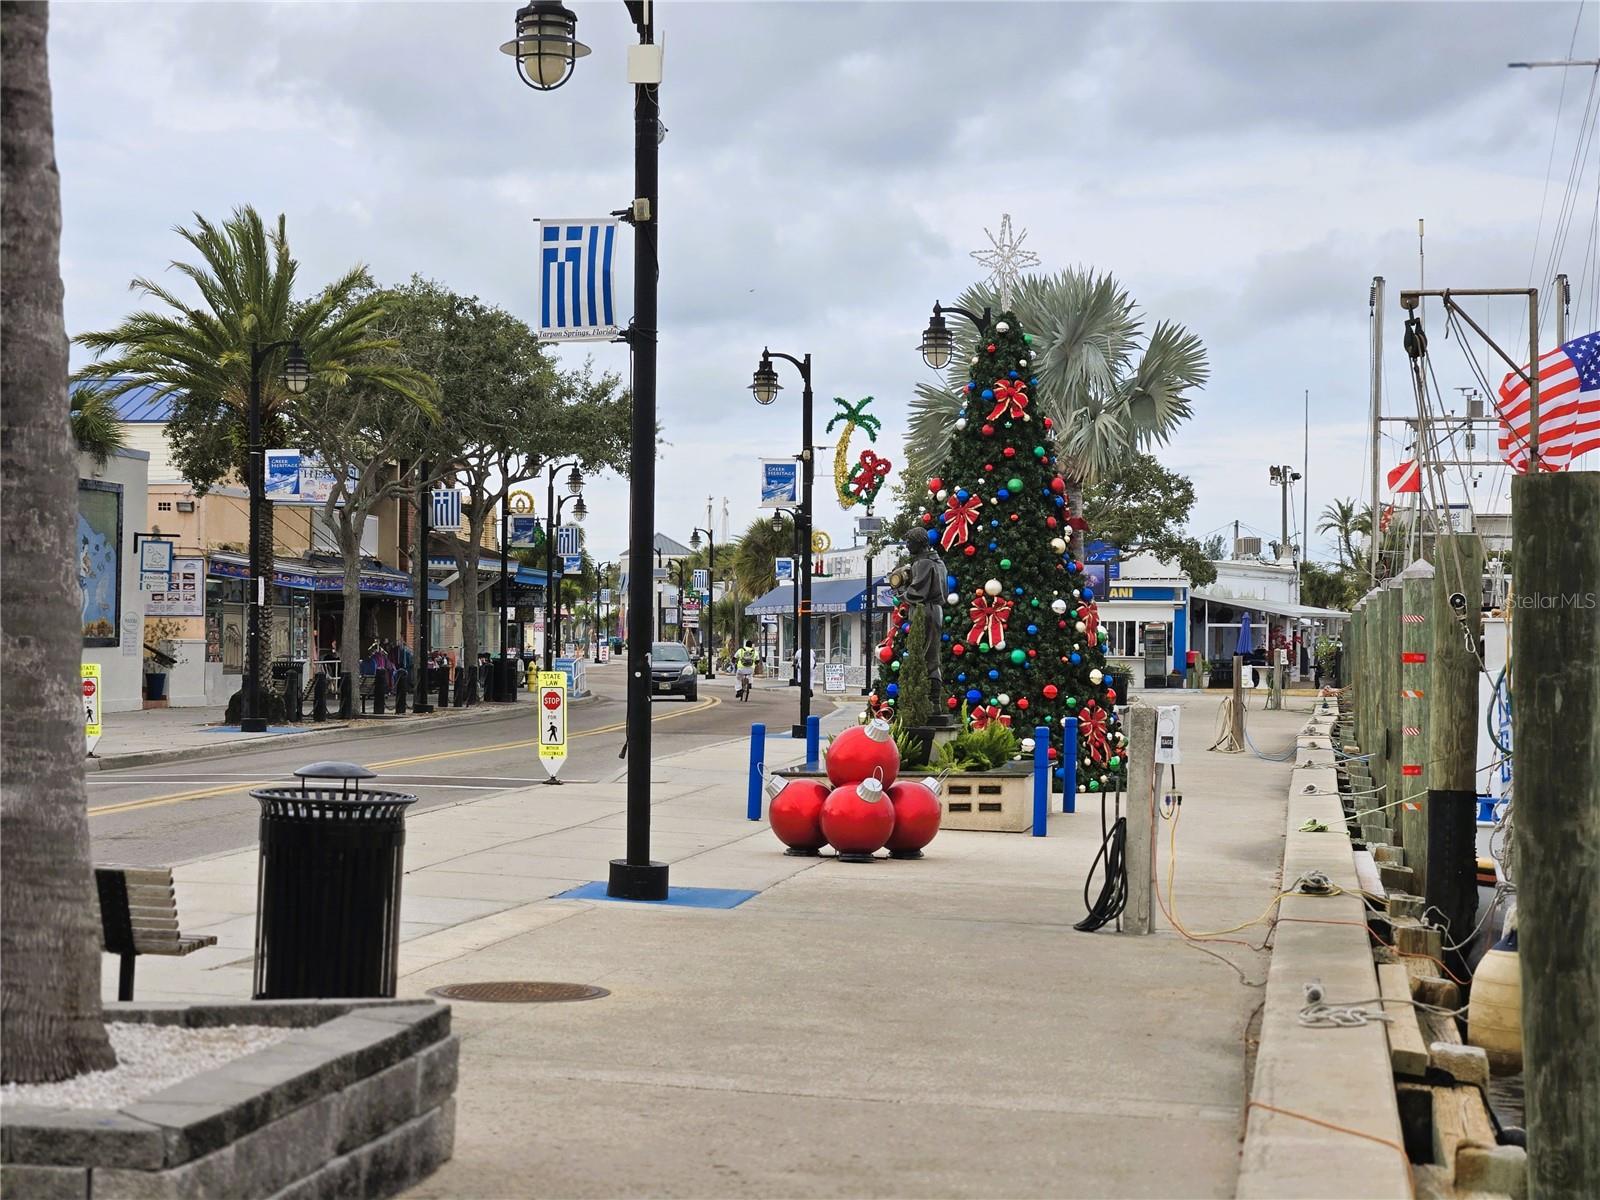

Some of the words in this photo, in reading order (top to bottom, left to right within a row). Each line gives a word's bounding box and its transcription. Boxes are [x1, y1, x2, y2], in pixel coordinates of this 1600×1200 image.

[539, 330, 562, 338] Tarpon
[563, 329, 591, 338] Springs,
[592, 327, 617, 336] Florida
[544, 697, 560, 705] STOP
